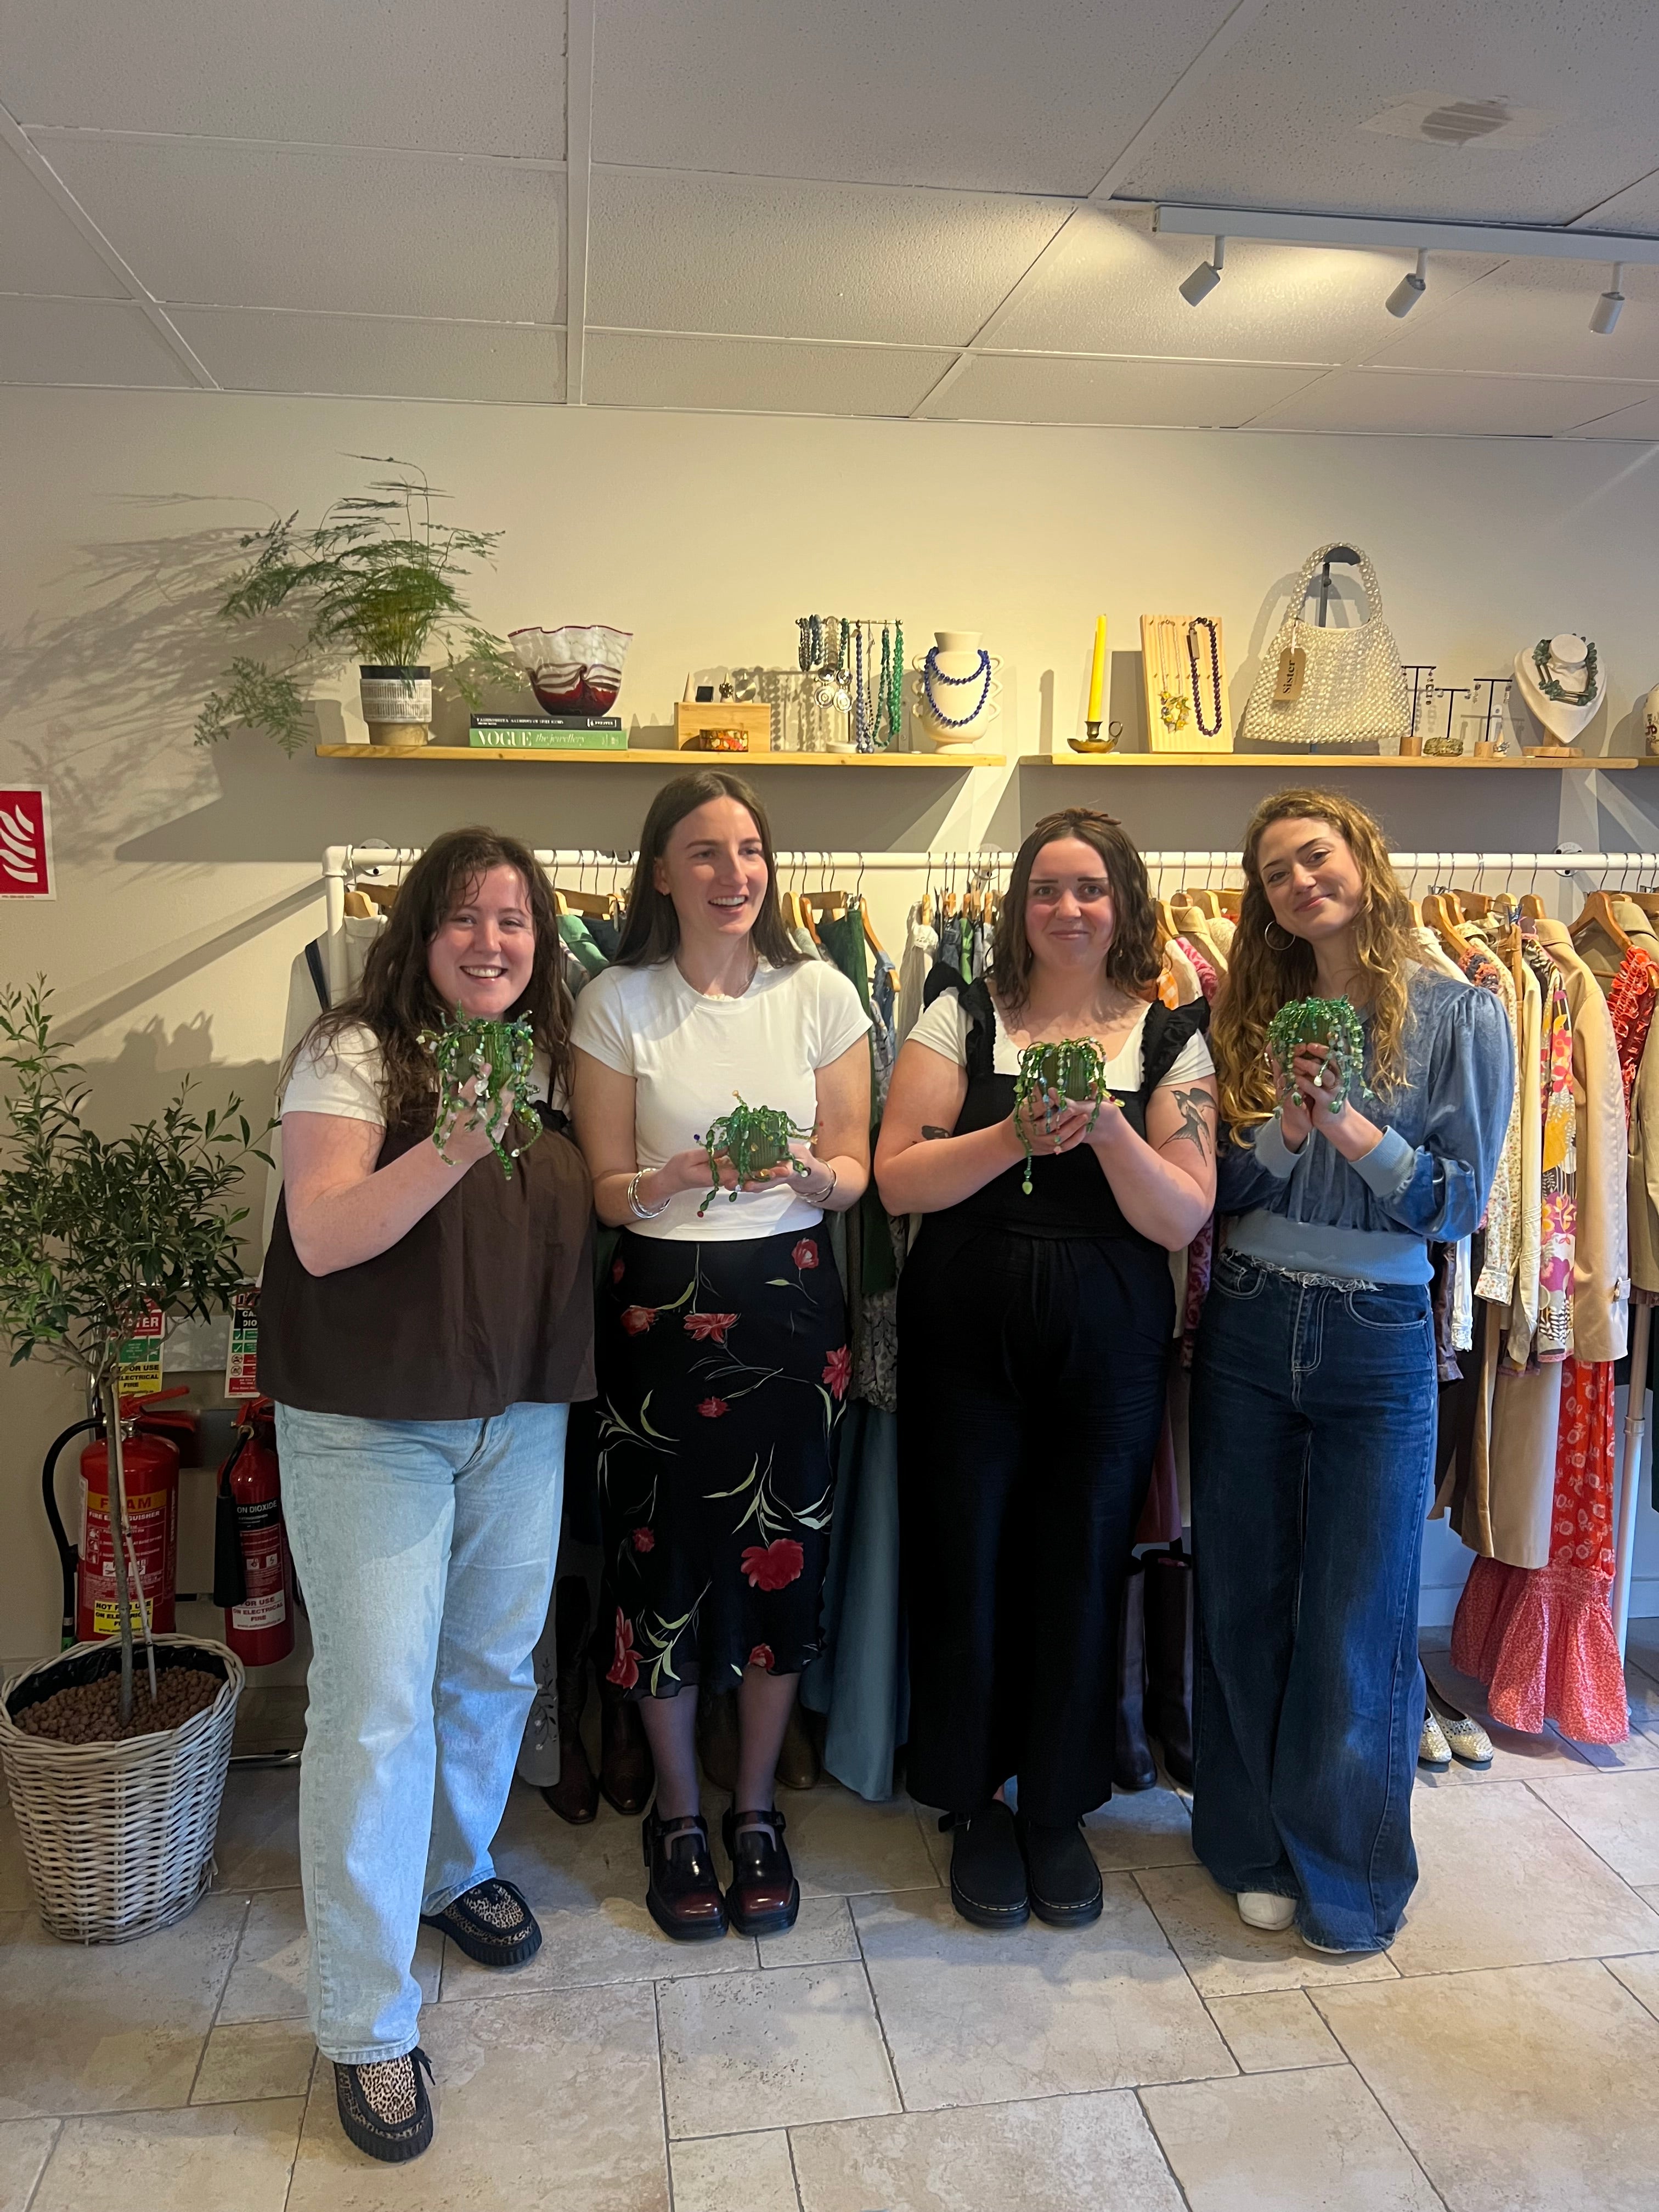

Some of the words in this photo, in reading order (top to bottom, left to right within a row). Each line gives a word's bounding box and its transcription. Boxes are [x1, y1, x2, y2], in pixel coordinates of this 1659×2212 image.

[1283, 659, 1295, 693] Sister
[478, 730, 532, 747] VOGUE
[535, 733, 549, 742] the
[547, 733, 585, 746] jewellery
[100, 1497, 151, 1509] FAM
[249, 1500, 277, 1513] DIOXIDE
[89, 1511, 103, 1520] FIRE
[135, 1600, 151, 1609] UE
[259, 1596, 275, 1605] USE
[243, 1602, 284, 1615] ELECTRICAL
